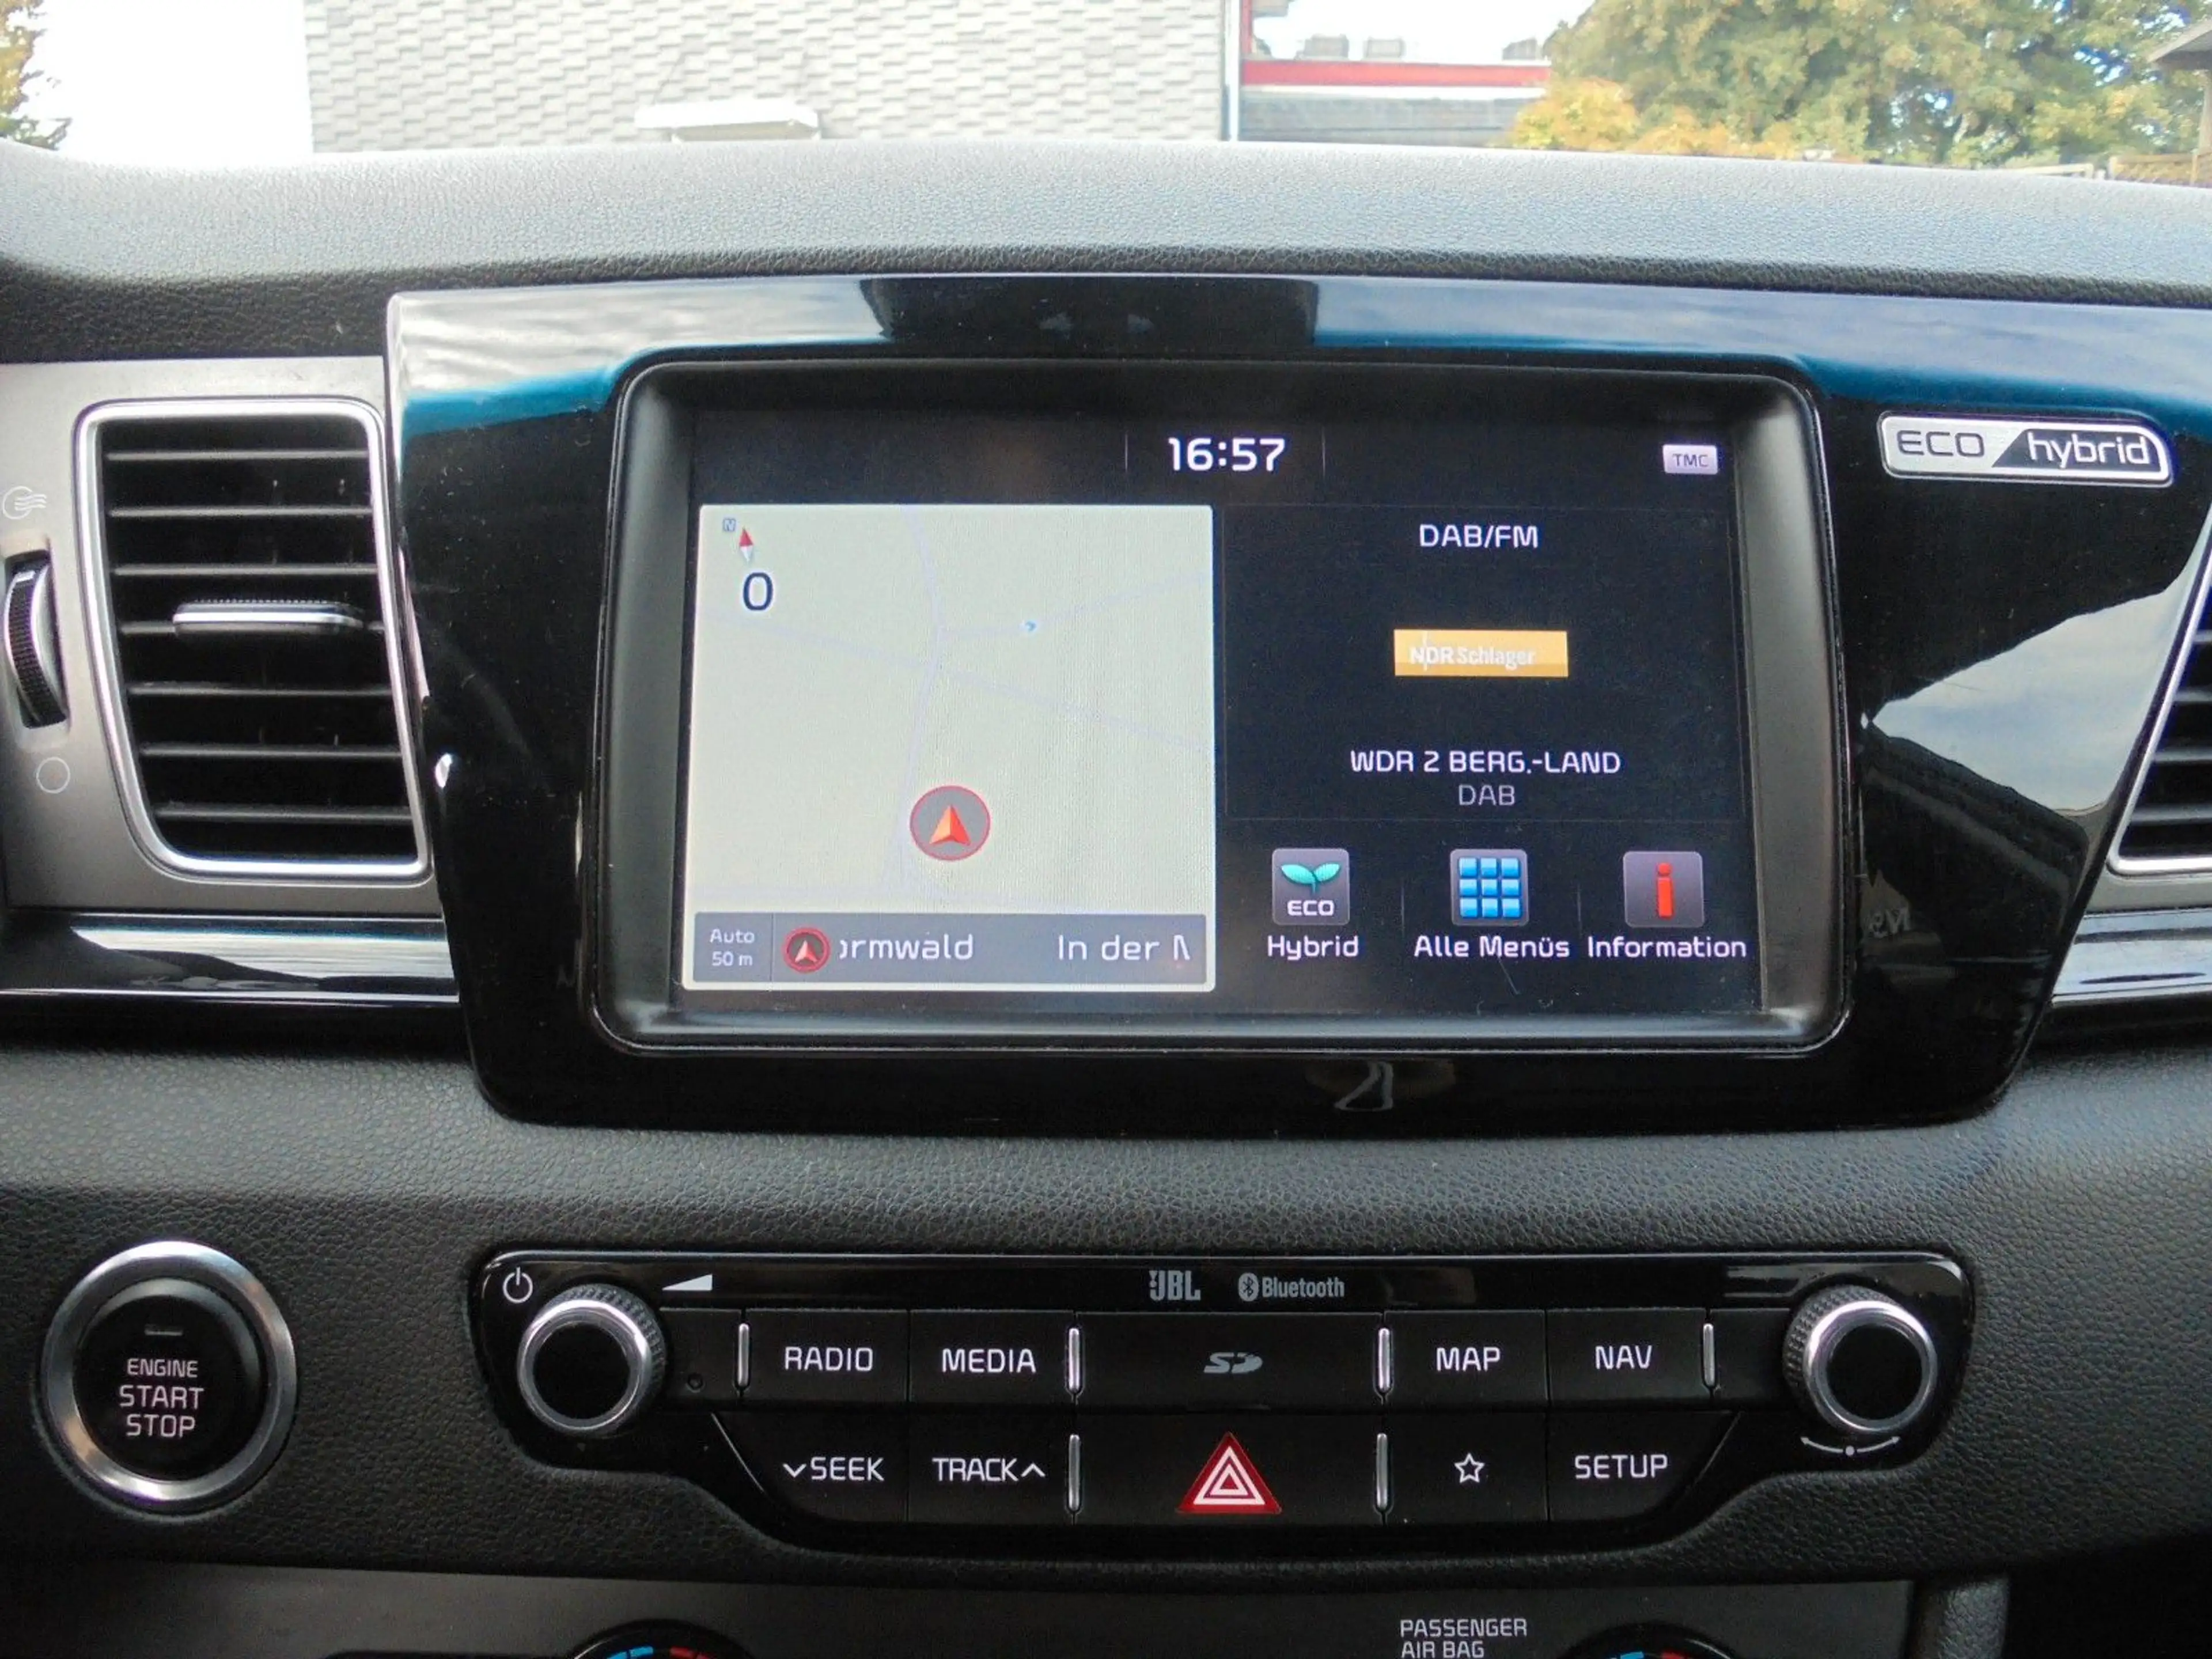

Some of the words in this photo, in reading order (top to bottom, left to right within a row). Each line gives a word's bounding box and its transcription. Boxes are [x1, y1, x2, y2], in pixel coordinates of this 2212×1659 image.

[1168, 437, 1285, 471] 16:57
[1673, 453, 1709, 468] TMC
[1896, 430, 1984, 457] ECO
[2027, 431, 2151, 468] hybrid
[1419, 524, 1538, 548] DAB/FM
[743, 572, 773, 611] 0
[1410, 639, 1454, 669] NDR
[1457, 645, 1537, 671] Schlager
[1350, 750, 1414, 772] WDR
[1423, 751, 1440, 772] 2
[1449, 751, 1621, 774] BERG.-LAND
[1459, 784, 1515, 806] DAB
[1287, 900, 1335, 916] ECO
[710, 929, 755, 944] Auto
[1058, 934, 1087, 960] In
[1101, 934, 1160, 961] der
[1267, 935, 1358, 961] Hybrid
[1414, 935, 1469, 957] Alle
[1480, 935, 1570, 958] Menüs
[1588, 935, 1747, 958] Information
[712, 950, 734, 967] 50
[738, 955, 753, 966] m
[1149, 1270, 1201, 1301] JBL
[1262, 1277, 1344, 1298] Bluetooth
[127, 1358, 198, 1378] ENGINE
[785, 1346, 873, 1372] RADIO
[942, 1348, 1036, 1373] MEDIA
[1203, 1352, 1263, 1374] SD
[1436, 1347, 1501, 1372] MAP
[1595, 1345, 1652, 1370] NAV
[119, 1384, 204, 1410] START
[126, 1413, 195, 1438] STOP
[810, 1456, 884, 1481] SEEK
[932, 1457, 1018, 1482] TRACK
[1574, 1454, 1668, 1479] SETUP
[1400, 1618, 1527, 1638] PASSENGER
[1401, 1641, 1435, 1659] AIR
[1443, 1641, 1484, 1659] BAG
